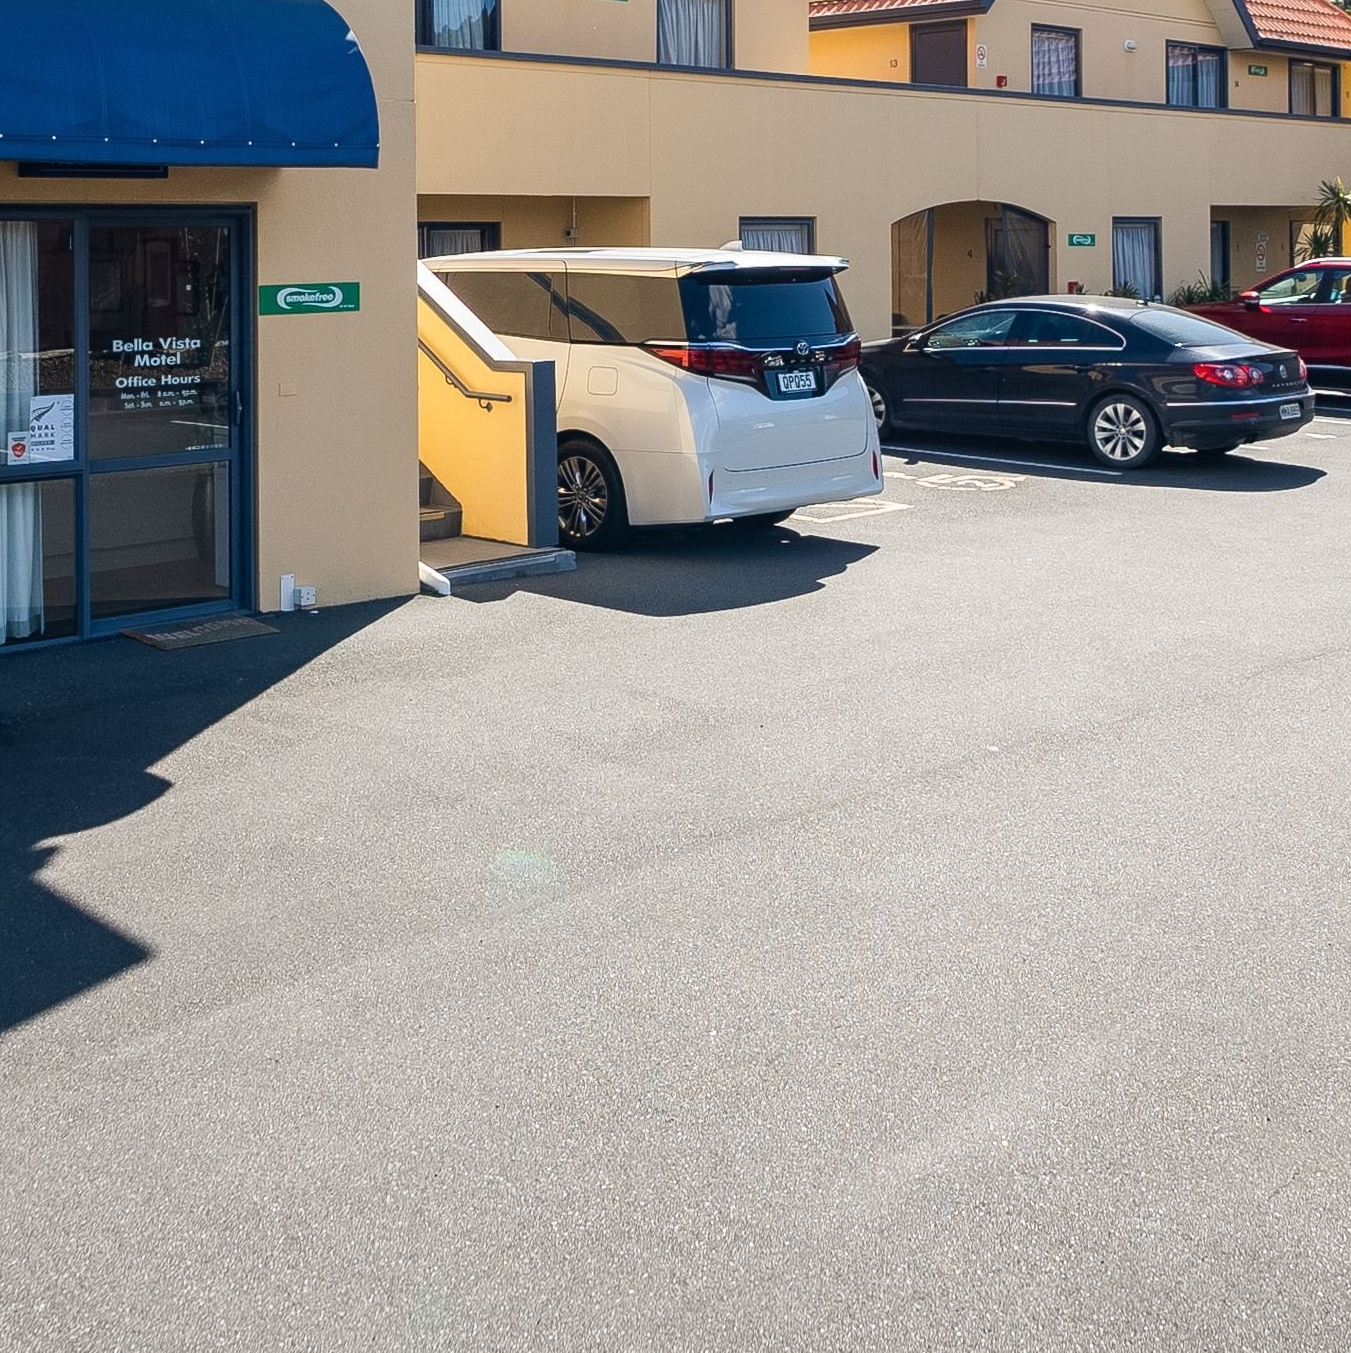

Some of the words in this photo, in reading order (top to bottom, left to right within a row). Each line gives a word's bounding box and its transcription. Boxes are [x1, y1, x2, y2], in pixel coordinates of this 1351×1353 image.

[890, 59, 898, 68] 13
[285, 292, 334, 303] smokefree
[112, 338, 153, 352] Bella
[159, 337, 201, 350] Vista
[134, 352, 181, 367] Motel
[115, 376, 157, 388] Office
[161, 375, 201, 385] Hours
[773, 373, 812, 389] QPQ55
[30, 424, 55, 432] QUAL
